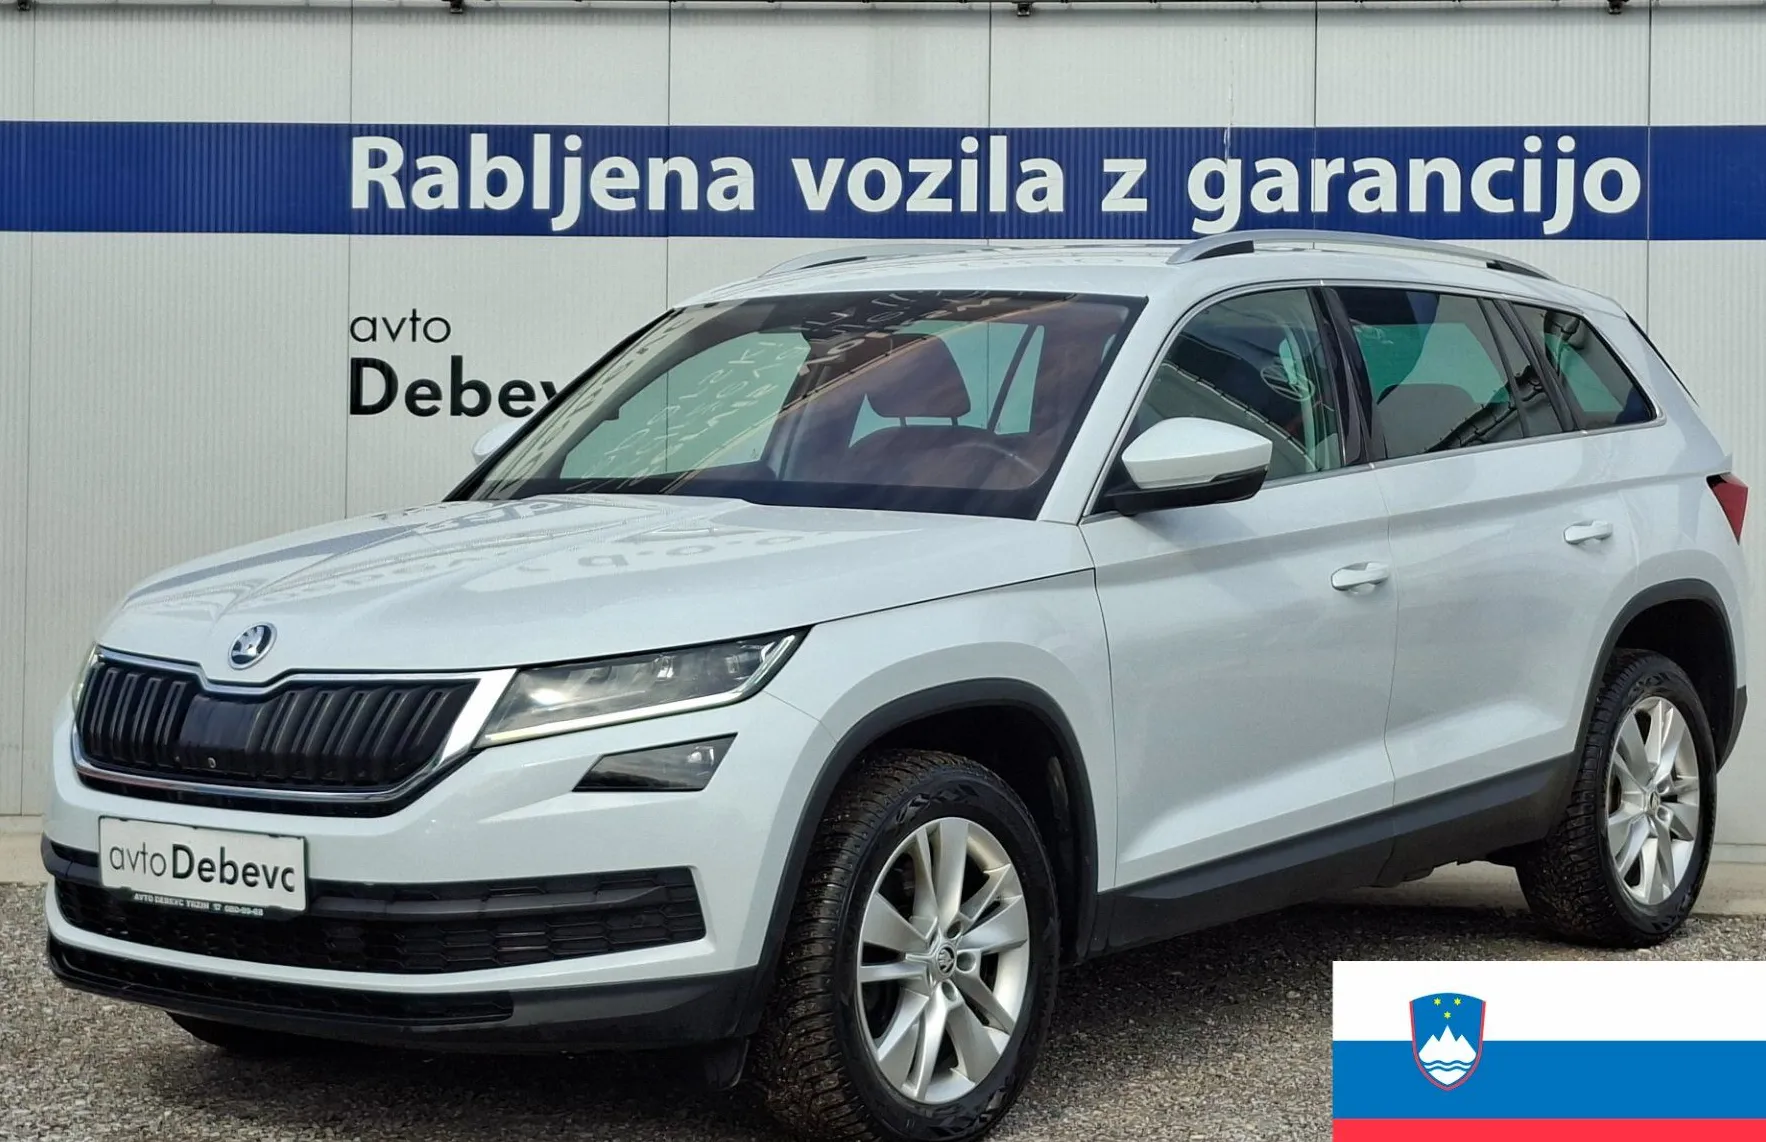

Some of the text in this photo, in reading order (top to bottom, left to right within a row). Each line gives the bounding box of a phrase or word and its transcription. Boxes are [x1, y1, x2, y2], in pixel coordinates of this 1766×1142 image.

[351, 132, 1642, 235] Rabljena vozila z garancijo
[350, 308, 452, 343] avto
